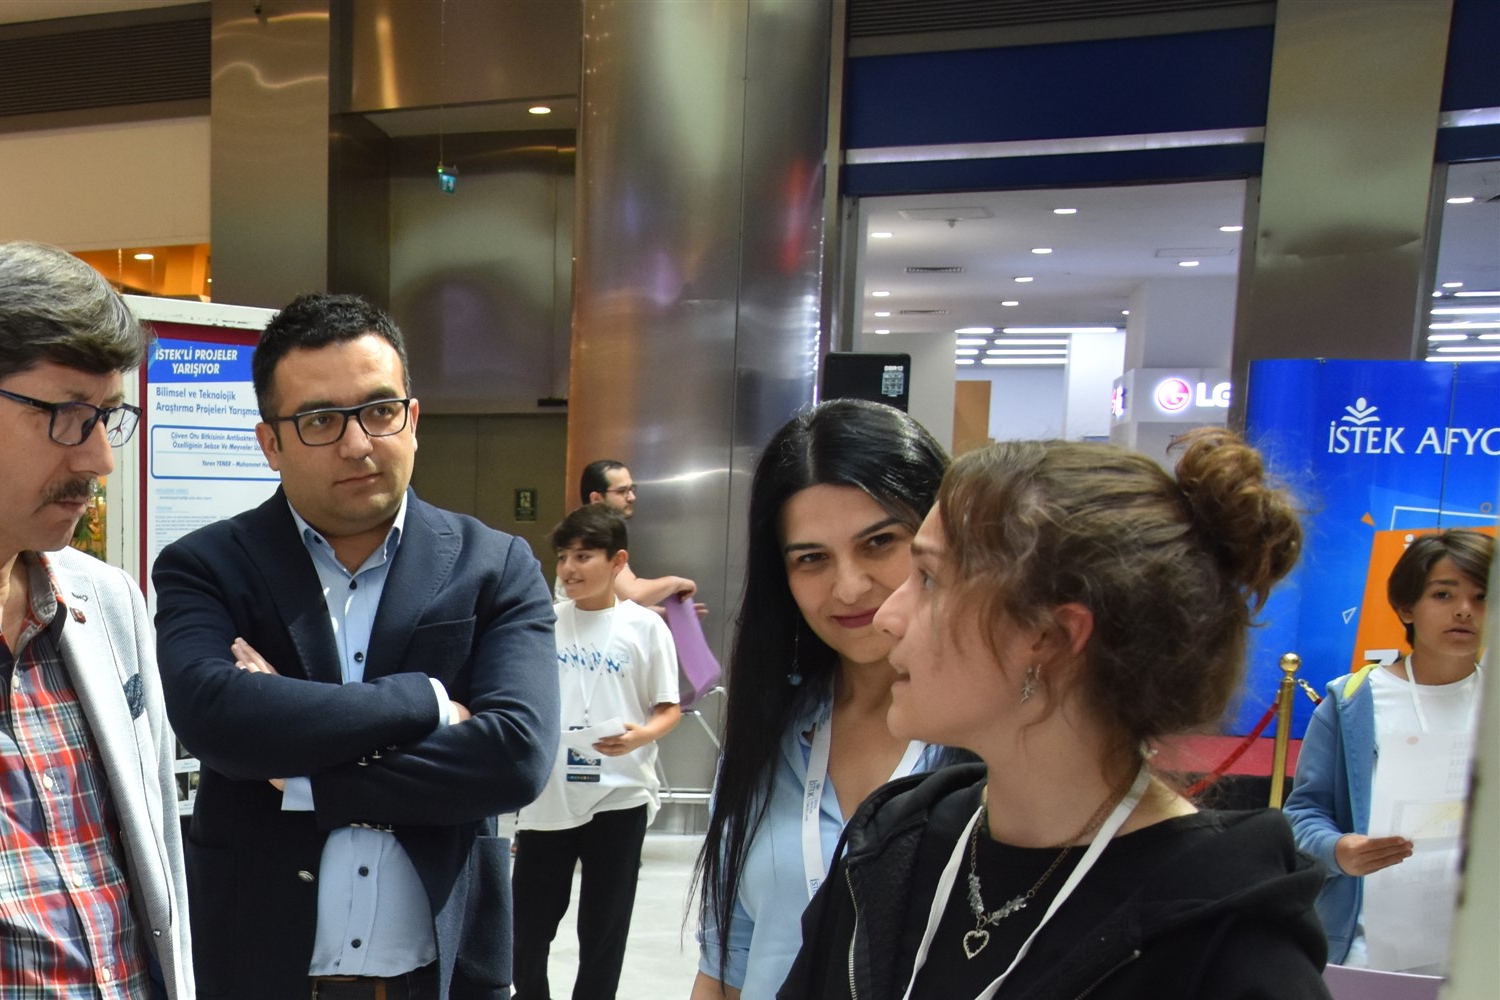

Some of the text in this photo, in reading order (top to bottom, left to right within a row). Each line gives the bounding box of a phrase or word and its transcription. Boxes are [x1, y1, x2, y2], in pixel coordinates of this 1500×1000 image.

[155, 346, 238, 361] İSTEK'Lİ PROJELER
[172, 363, 220, 377] YARIŞIYOR
[156, 387, 186, 398] Bilimsel
[199, 389, 236, 402] Teknolojik
[1195, 382, 1231, 408] LG
[156, 402, 260, 418] Araştırma Projeleri Yarışmas
[1328, 420, 1405, 454] İSTEK
